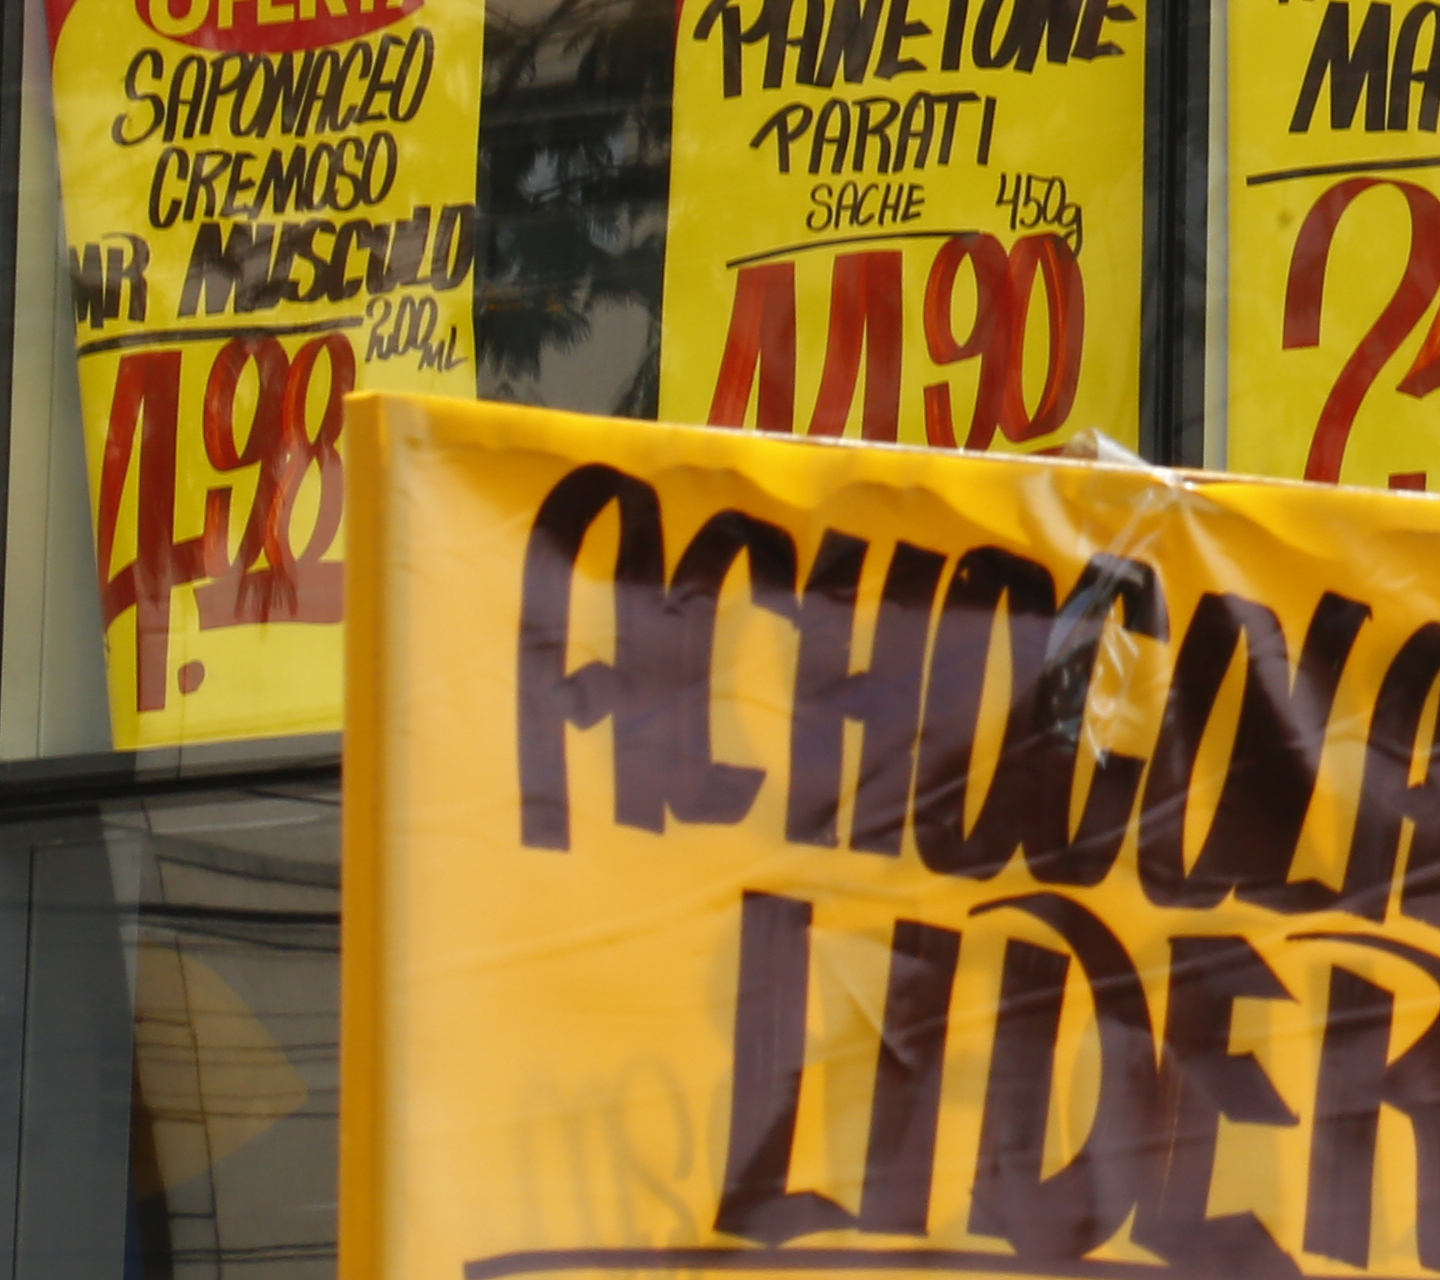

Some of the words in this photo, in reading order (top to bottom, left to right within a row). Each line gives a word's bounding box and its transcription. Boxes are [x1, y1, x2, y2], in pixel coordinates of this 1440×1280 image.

[112, 27, 434, 146] SAPONACEO
[751, 91, 996, 174] PARATI
[149, 132, 397, 229] CREMOSO
[806, 182, 926, 231] SACHE
[996, 173, 1083, 257] 450g
[178, 204, 474, 318] MUSCULO
